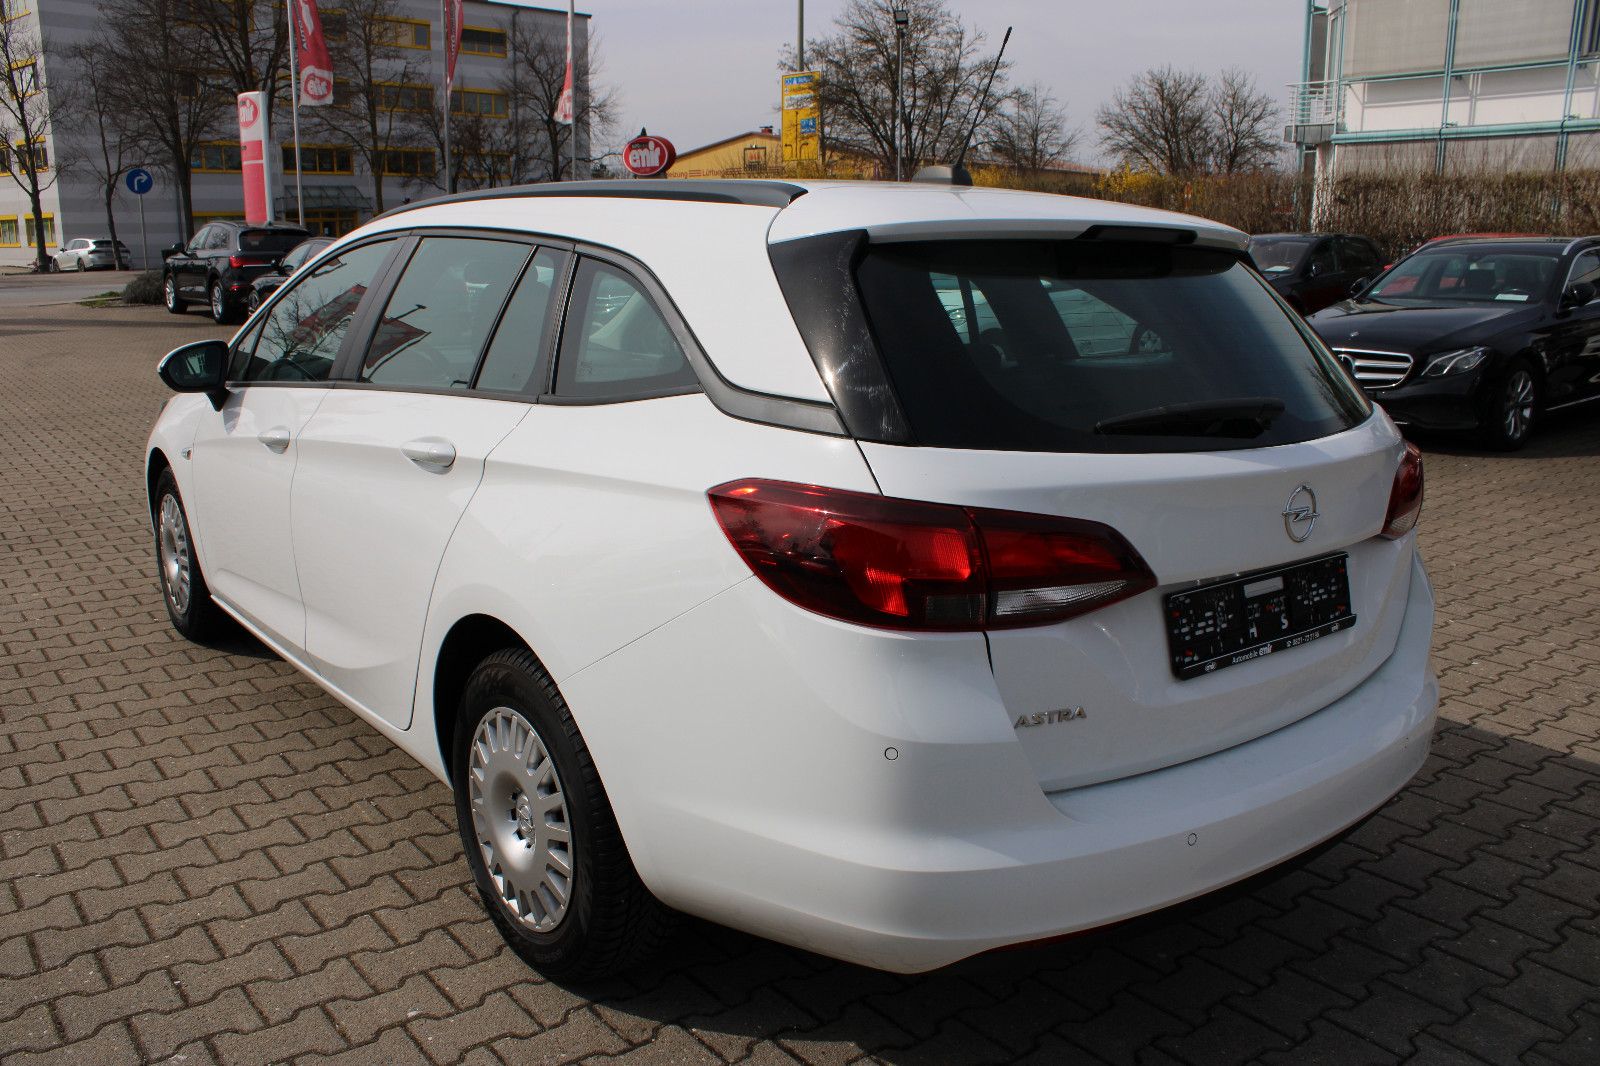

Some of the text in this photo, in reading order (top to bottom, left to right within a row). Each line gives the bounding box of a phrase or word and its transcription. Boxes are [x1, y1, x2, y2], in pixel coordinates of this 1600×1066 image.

[629, 140, 660, 168] emir
[667, 170, 688, 179] eizung
[1259, 643, 1273, 656] emir
[1014, 706, 1087, 729] ASTRA
